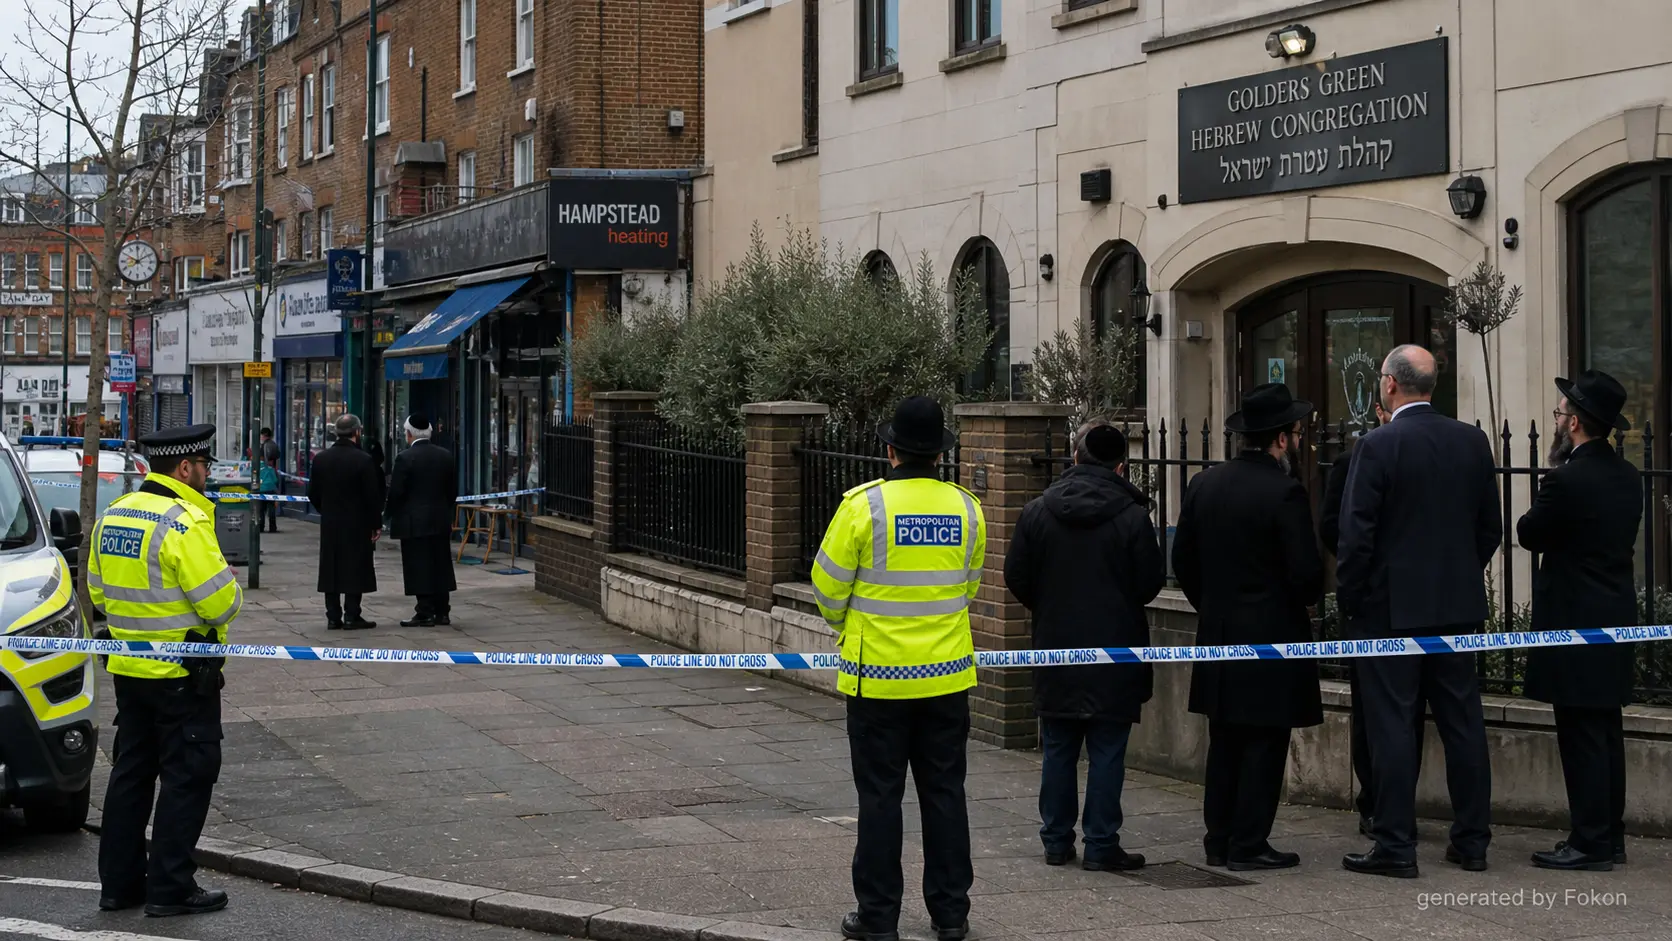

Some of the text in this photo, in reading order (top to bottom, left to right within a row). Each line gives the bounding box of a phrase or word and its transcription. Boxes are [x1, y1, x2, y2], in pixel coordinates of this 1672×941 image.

[1227, 62, 1386, 113] GOLDERS GREEN
[1191, 91, 1429, 151] HEBREW CONGREGATION
[1220, 136, 1393, 184] קהלת עטרת ישראל
[559, 204, 660, 224] HAMPSTEAD
[608, 227, 669, 248] heating
[897, 518, 960, 526] METROPOLITAN
[898, 527, 960, 543] POLICE
[101, 536, 140, 555] POLICE
[1455, 630, 1572, 648] POLICE LINE DO NOT CROSS
[1616, 628, 1646, 640] POLICE
[1650, 626, 1668, 638] LINE
[74, 640, 94, 650] NOT
[95, 640, 122, 652] CROSS
[160, 642, 276, 656] POLICE LINE DO NOT CROSS
[1143, 645, 1255, 660] POLICE LINE DO NOT CROSS
[1286, 639, 1406, 656] POLICE LINE DO NOT CROSS
[322, 648, 440, 661] POLICE LINE DO NOT CROSS
[486, 652, 604, 665] POLICE LINE DO NOT CROSS
[650, 654, 767, 667] POLICE LINE DO NOT CROSS
[980, 649, 1097, 666] POLICE LINE DO NOT CROSS
